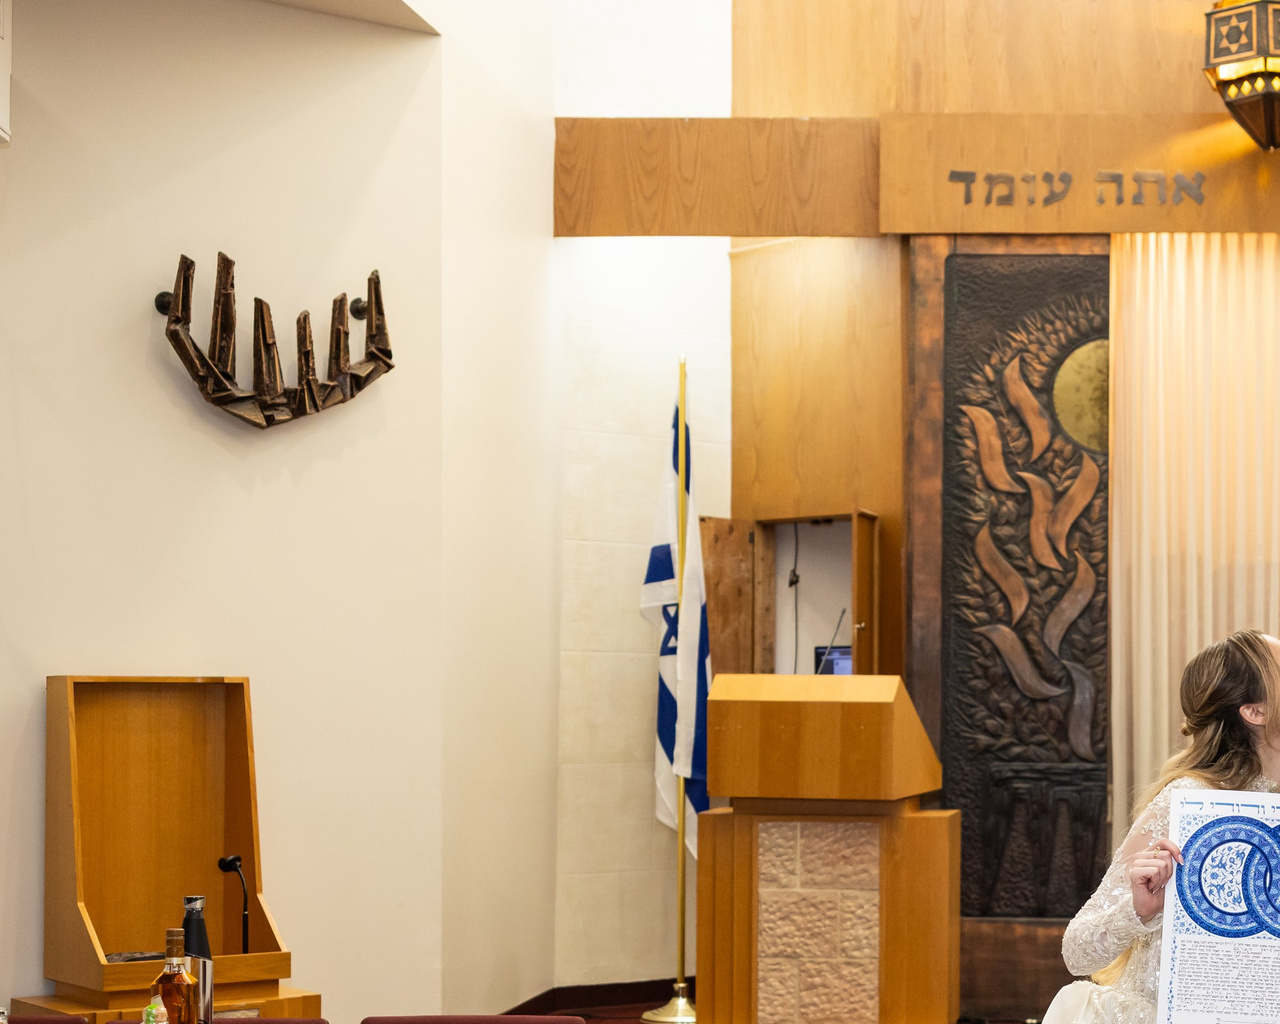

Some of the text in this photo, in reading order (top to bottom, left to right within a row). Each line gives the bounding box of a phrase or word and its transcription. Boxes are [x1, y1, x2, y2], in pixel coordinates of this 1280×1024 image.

[948, 169, 1074, 207] עומד
[1096, 169, 1206, 206] אתה
[1180, 797, 1205, 811] לי
[1210, 801, 1266, 815] ודודי
